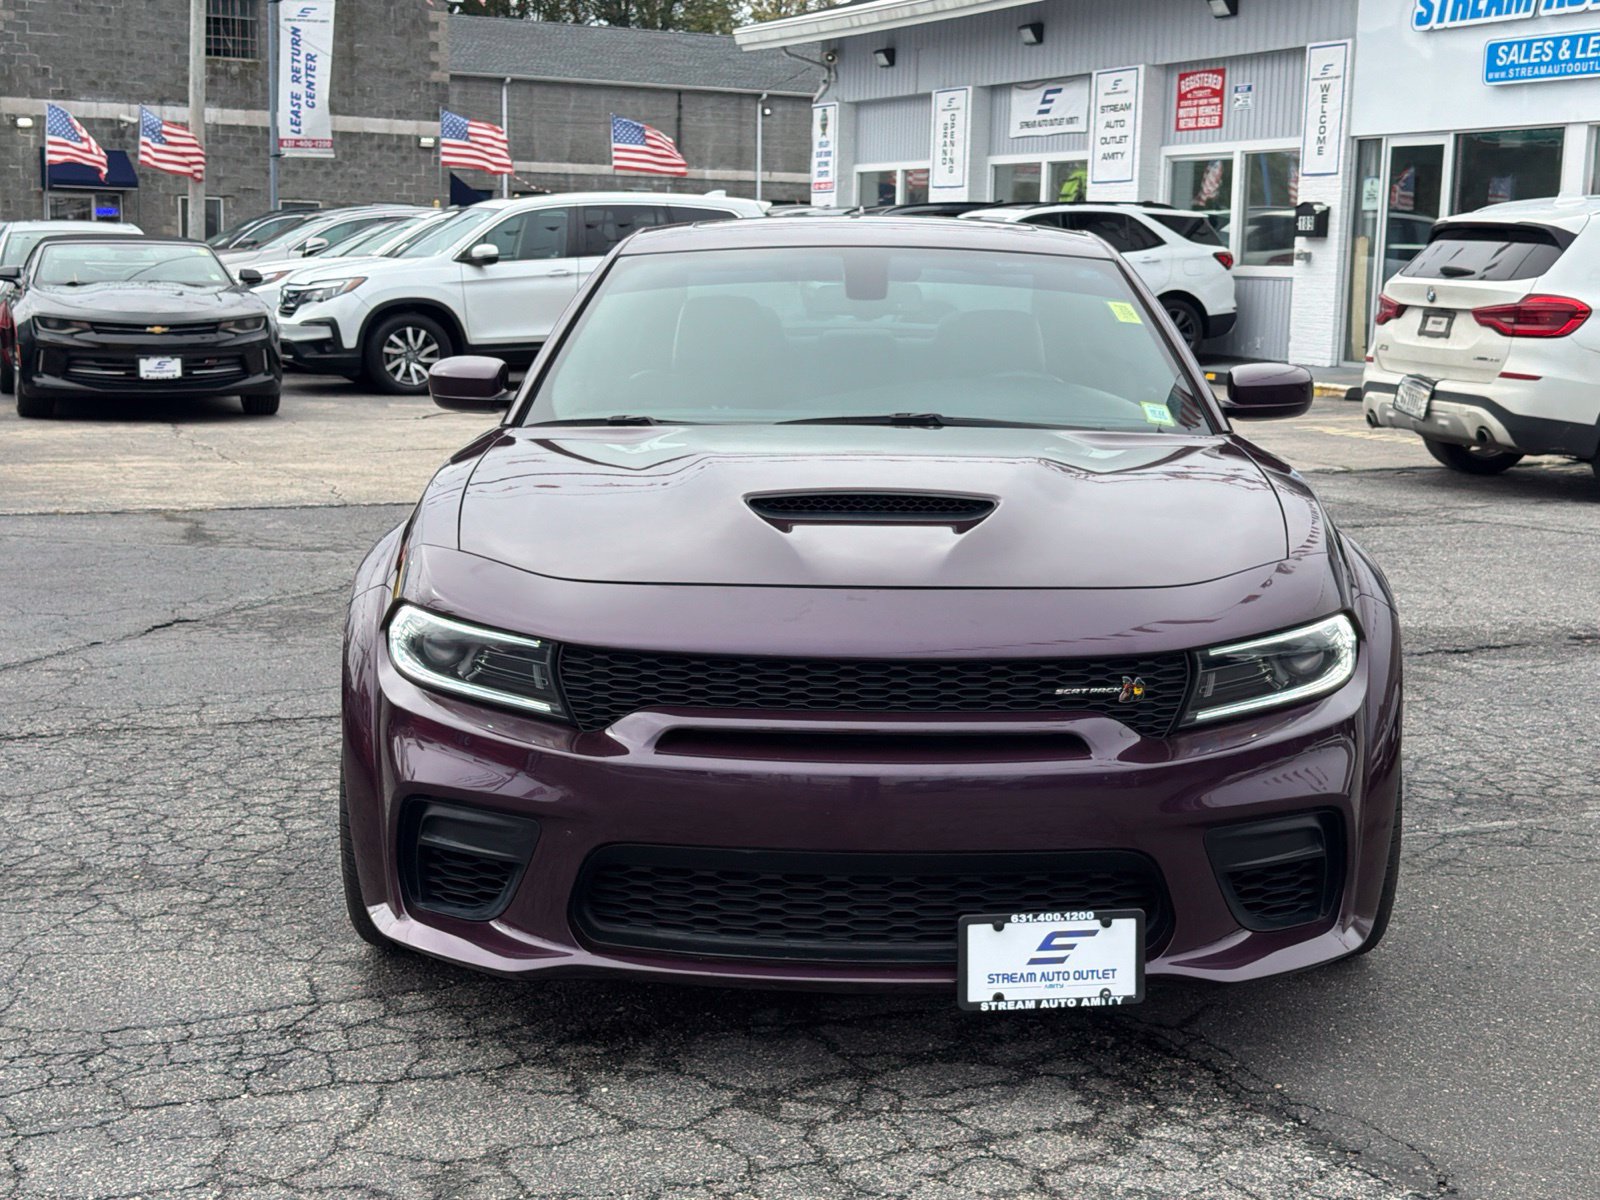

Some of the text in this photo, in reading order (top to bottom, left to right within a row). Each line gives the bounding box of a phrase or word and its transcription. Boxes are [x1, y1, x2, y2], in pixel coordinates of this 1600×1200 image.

[1496, 36, 1600, 66] SALES & LE
[290, 26, 302, 135] LEASE RETURN
[305, 52, 318, 109] CENTER
[1100, 102, 1132, 114] STREAM
[1104, 119, 1126, 129] AUTO
[1316, 84, 1331, 156] WELCOME
[1100, 135, 1129, 145] OUTLET
[1101, 151, 1125, 160] AMITY
[1010, 911, 1095, 924] 631.400.1200
[987, 968, 1117, 985] STREAM AUTO OUTLET
[980, 1000, 1036, 1012] STREAM
[1039, 997, 1077, 1009] AUTO
